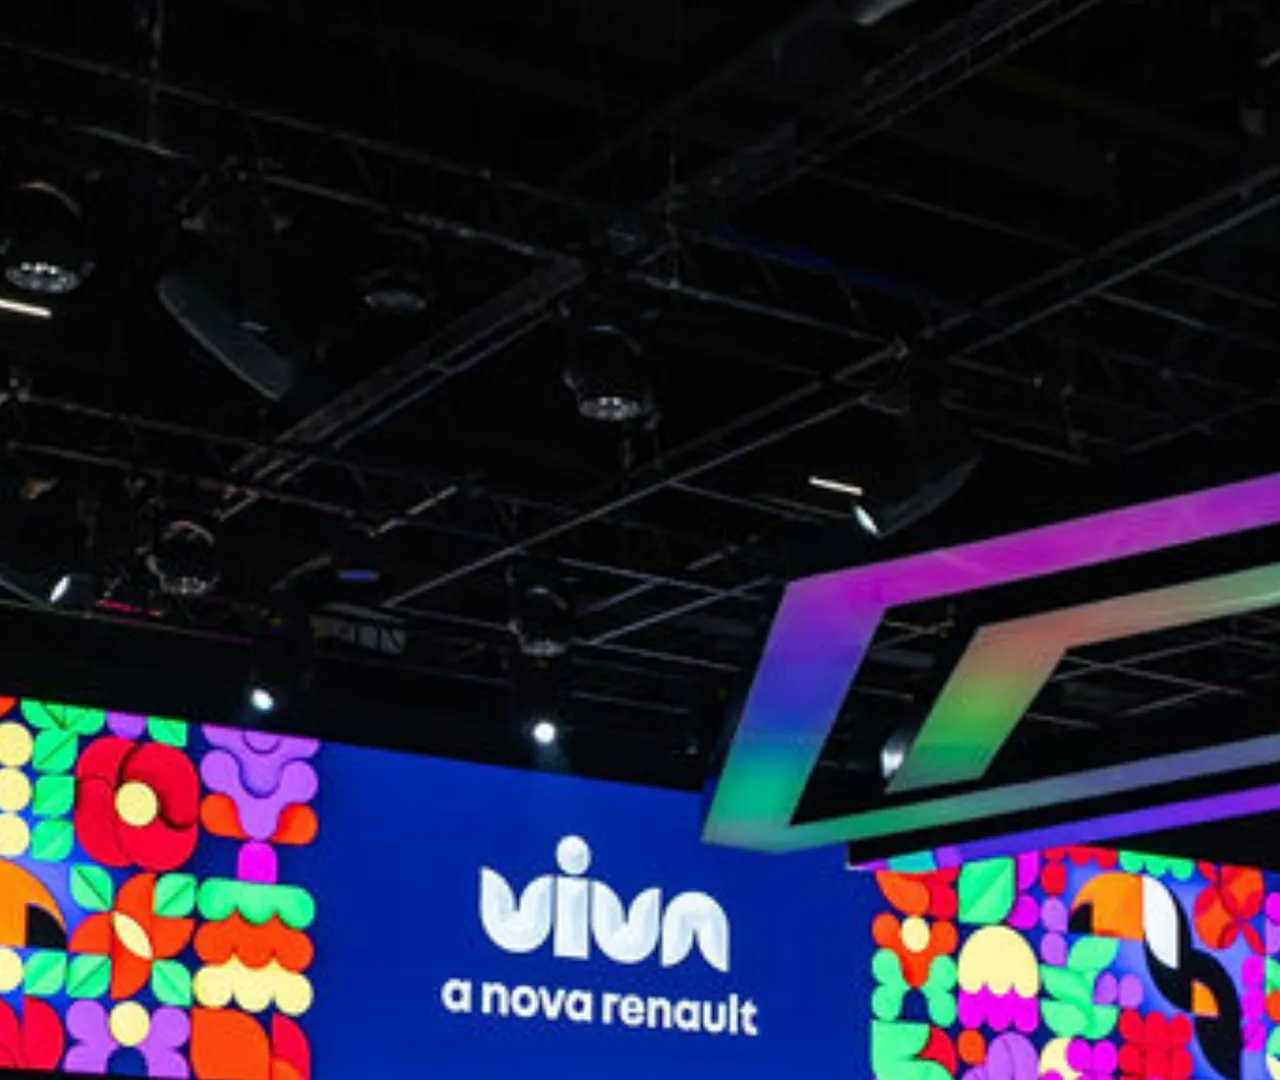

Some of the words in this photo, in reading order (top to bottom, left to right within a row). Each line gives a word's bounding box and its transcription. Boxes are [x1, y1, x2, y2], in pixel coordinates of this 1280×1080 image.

[479, 834, 730, 973] viva
[441, 977, 472, 1013] a
[480, 980, 593, 1024] nova
[601, 992, 759, 1036] renault
